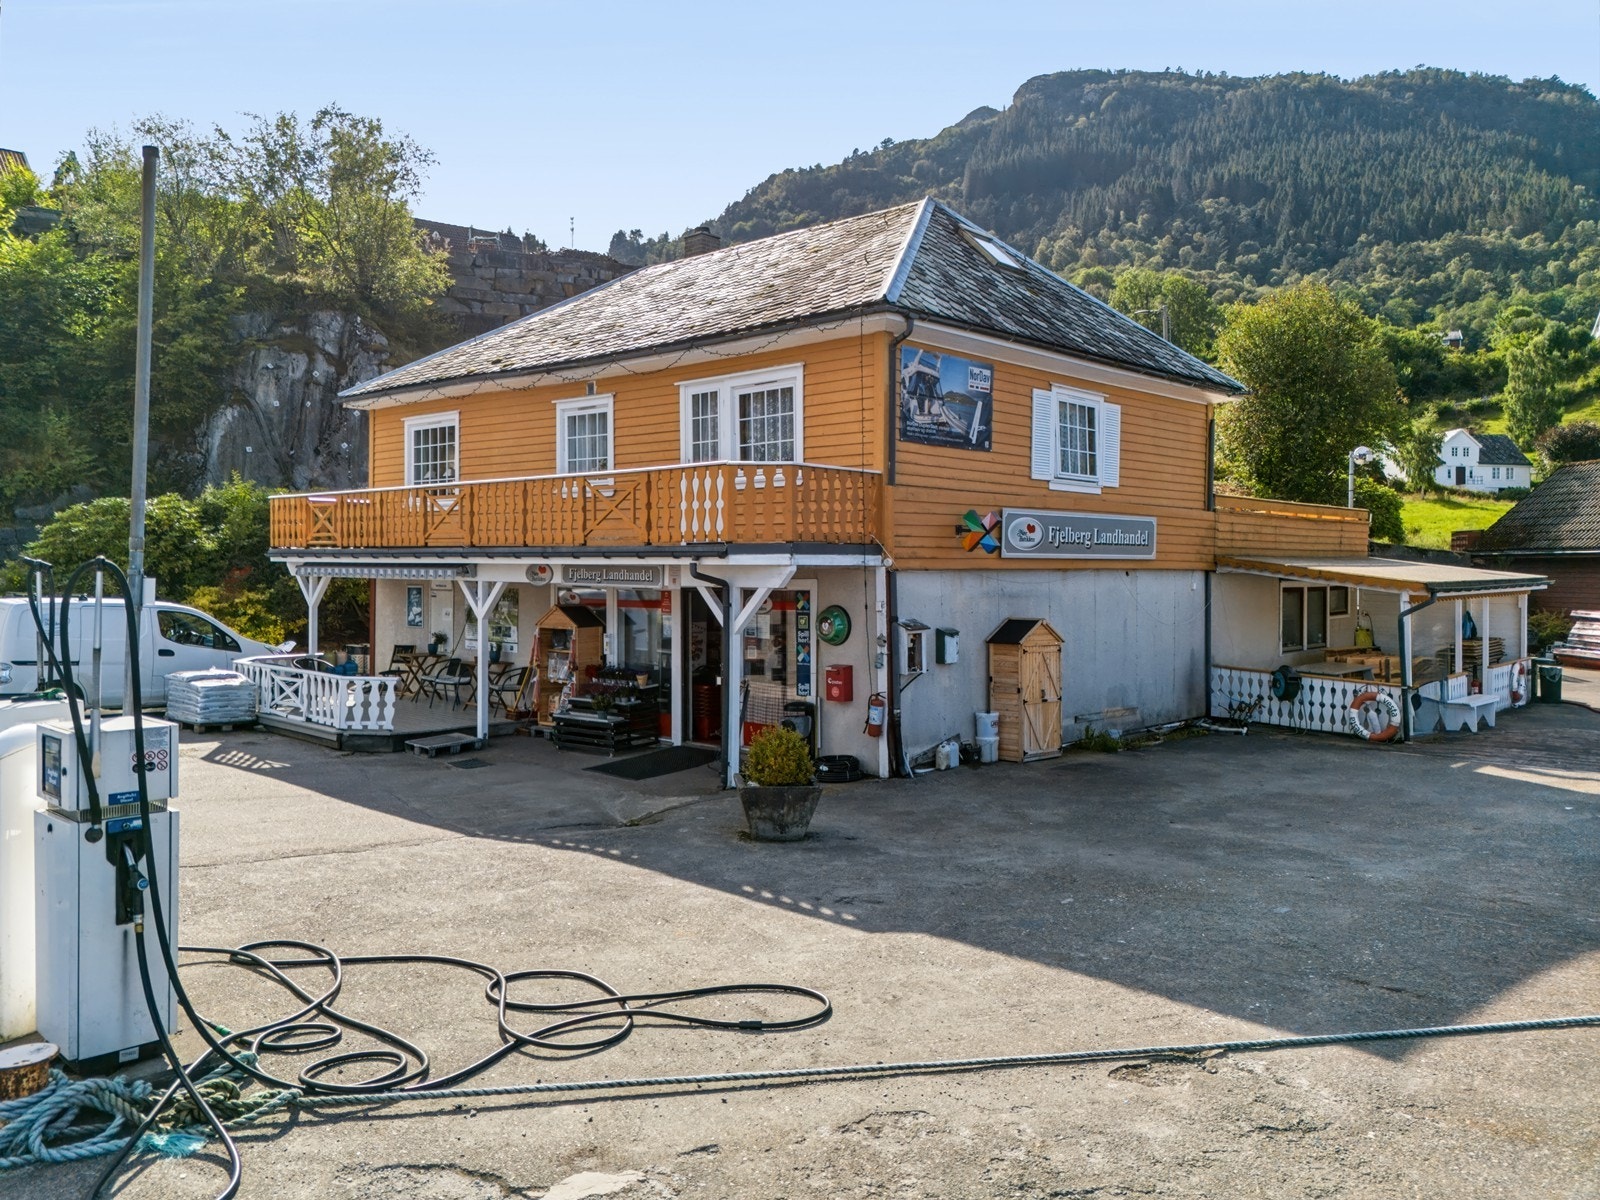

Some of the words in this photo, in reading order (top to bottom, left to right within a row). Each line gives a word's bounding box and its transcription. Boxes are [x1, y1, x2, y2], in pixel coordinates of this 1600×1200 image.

[1048, 526, 1091, 548] Fjelberg
[1094, 528, 1149, 546] Landhandel
[568, 568, 602, 583] Fjelberg
[603, 569, 654, 582] Landhandel
[1383, 698, 1398, 718] vesta
